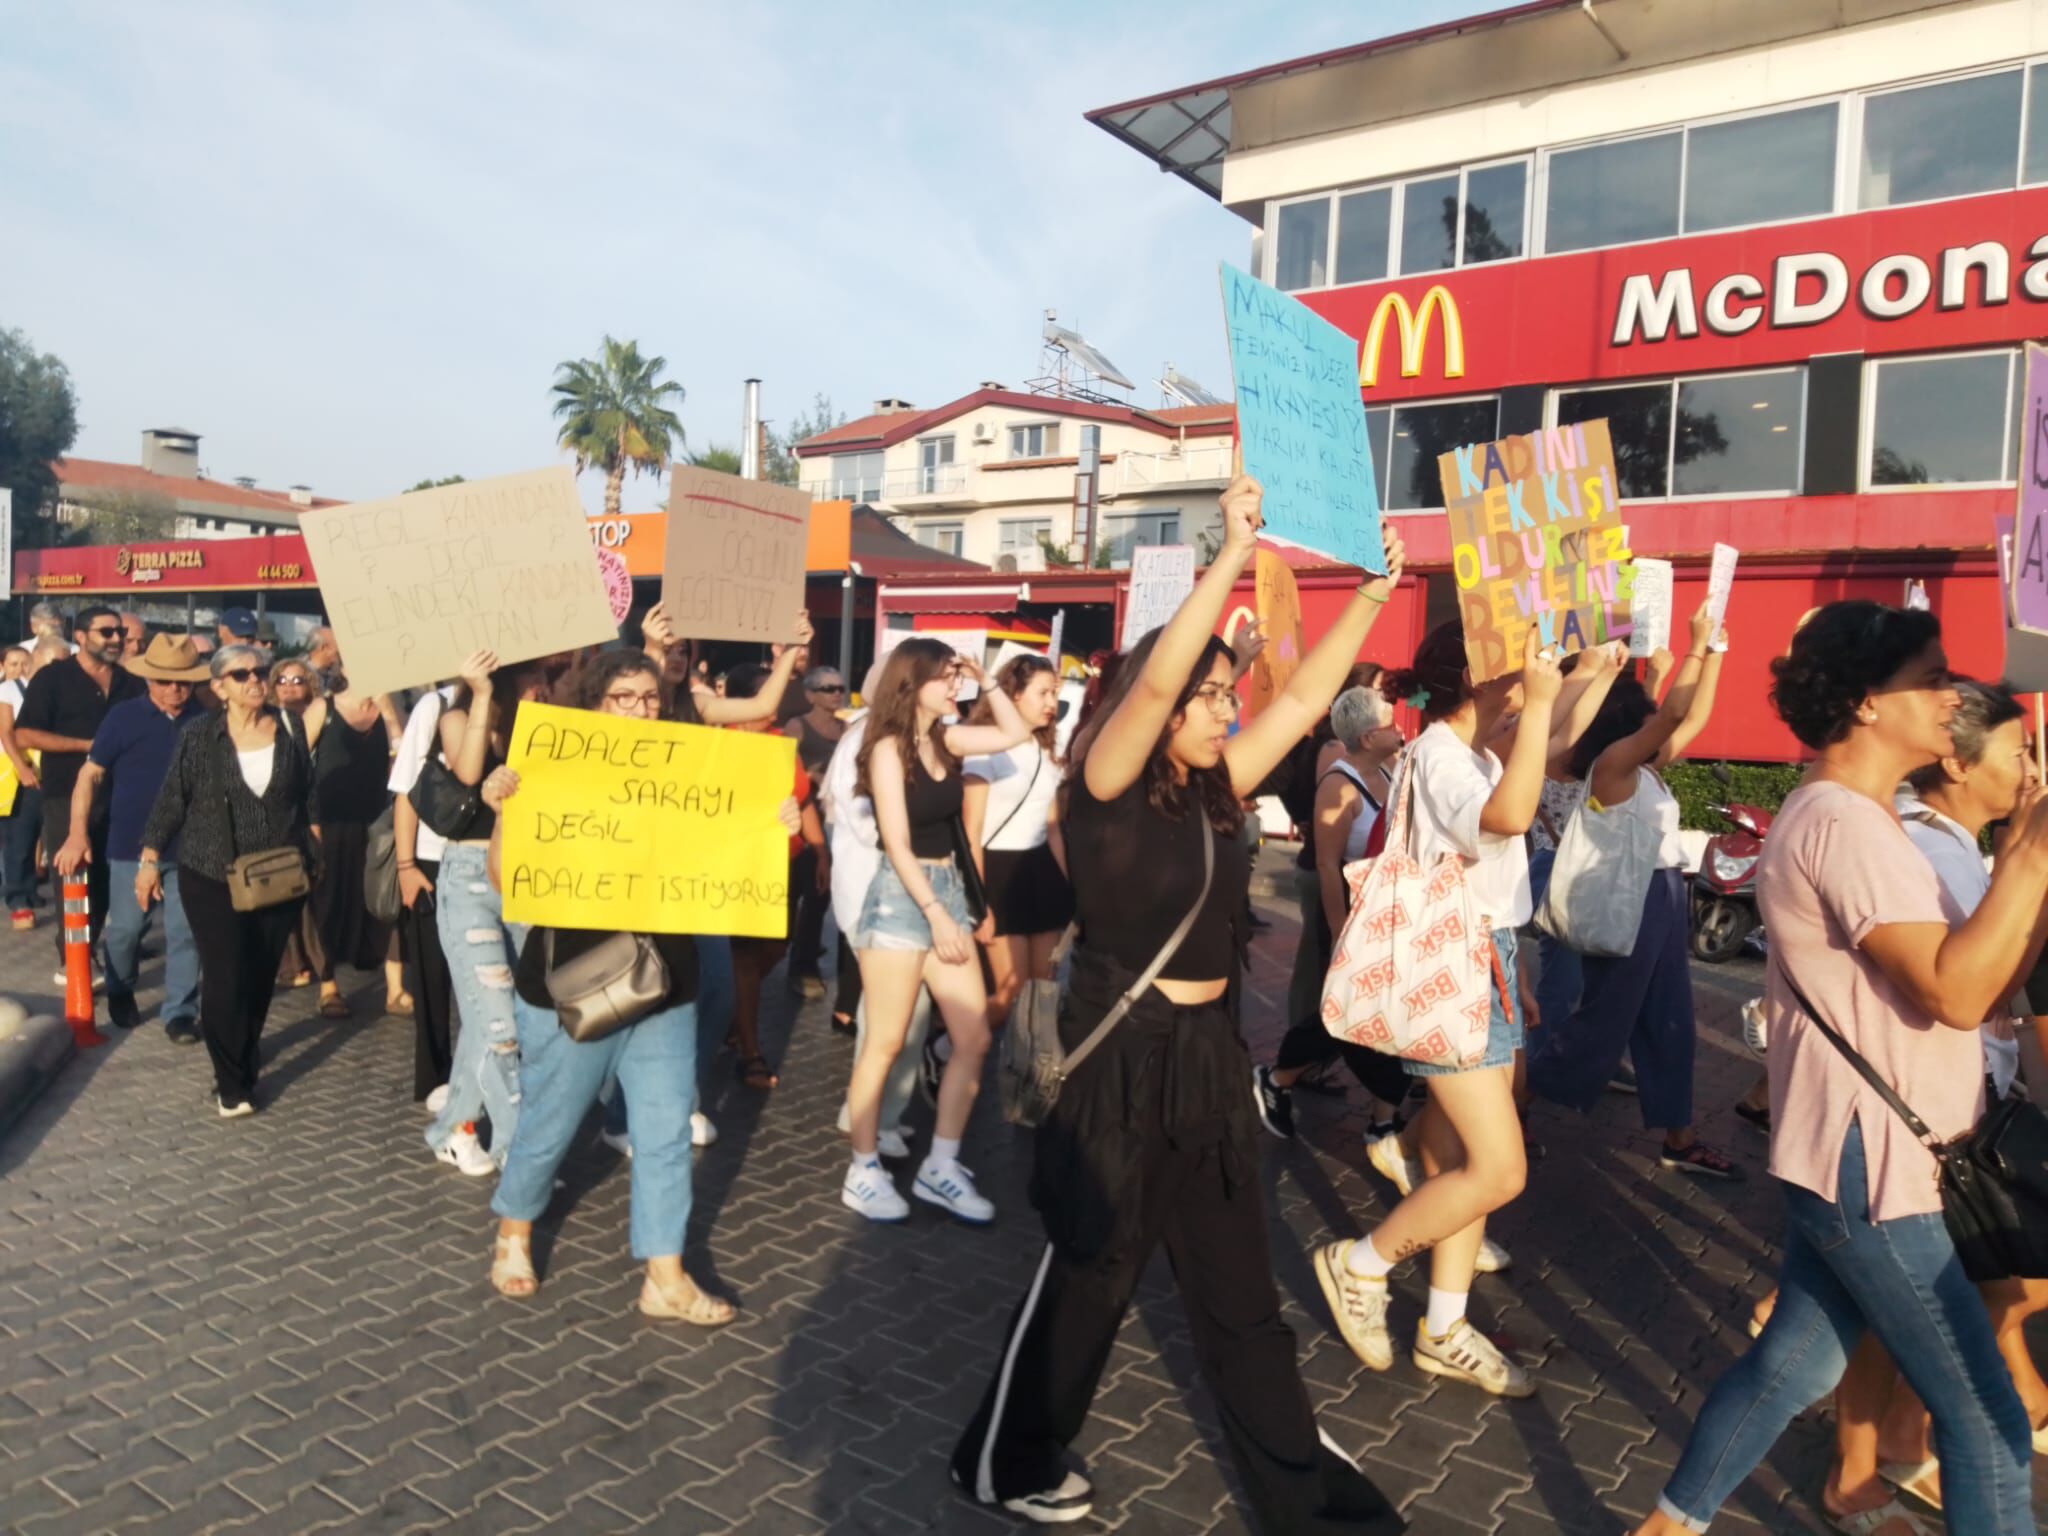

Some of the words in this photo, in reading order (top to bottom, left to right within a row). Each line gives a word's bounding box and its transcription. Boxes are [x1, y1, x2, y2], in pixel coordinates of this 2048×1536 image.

[1454, 422, 1589, 498] KADINI
[1451, 481, 1537, 541] TEK
[588, 519, 632, 547] TOP
[132, 551, 167, 569] TERRA
[525, 722, 687, 768] ADALET
[608, 778, 735, 818] SARAYI
[511, 863, 643, 901] ADALET
[1415, 913, 1463, 956] Bsk
[1405, 970, 1456, 1014] Bsk
